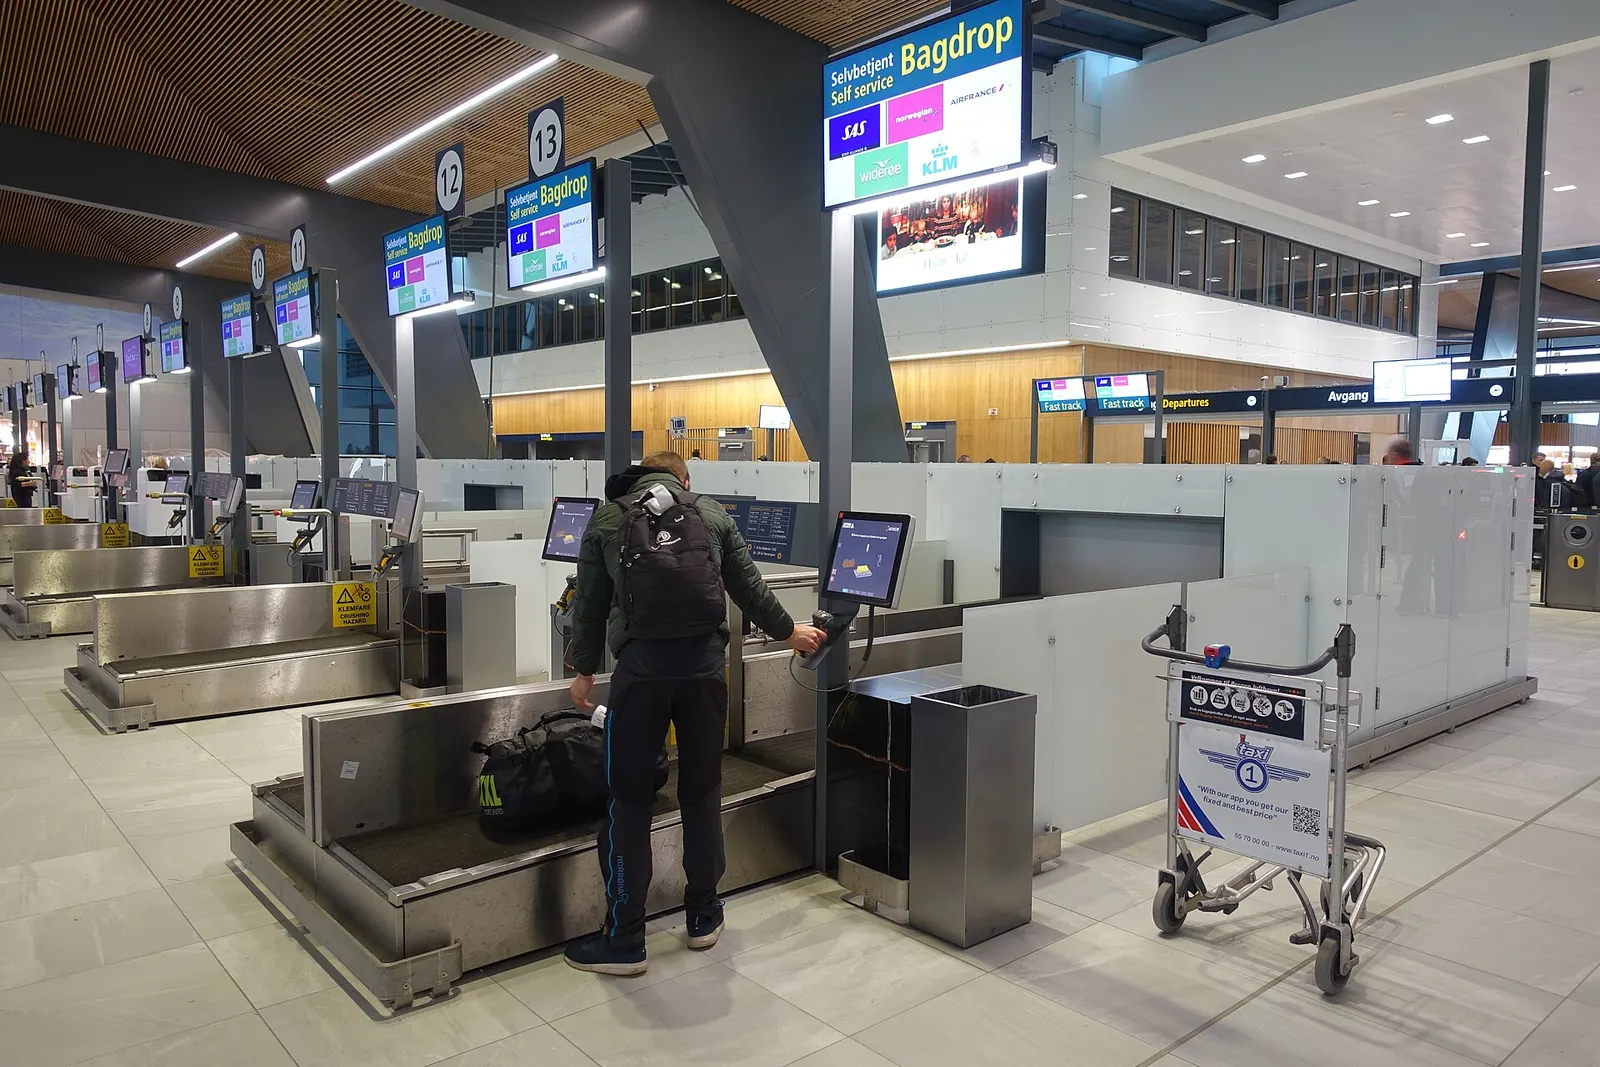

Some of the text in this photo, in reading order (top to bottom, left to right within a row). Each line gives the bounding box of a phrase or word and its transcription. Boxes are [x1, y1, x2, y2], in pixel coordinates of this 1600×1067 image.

[901, 15, 1013, 76] Bagdrop
[832, 52, 894, 87] Selvbetjent
[832, 75, 894, 106] Self service
[895, 107, 933, 124] norwegian
[842, 120, 867, 141] SAS
[534, 124, 557, 162] 13
[922, 156, 958, 176] KLM
[441, 164, 458, 197] 12
[510, 190, 538, 208] Selvbetjent
[541, 175, 588, 207] Bagdrop
[510, 204, 538, 220] Self service
[408, 224, 442, 250] Bagdrop
[516, 232, 528, 244] SAS
[294, 240, 302, 262] 11
[254, 258, 262, 279] 10
[552, 260, 568, 273] KLM
[288, 276, 308, 294] Bagdrop
[1103, 399, 1120, 408] Fast
[1122, 398, 1144, 408] track
[1162, 398, 1210, 409] Departures
[1328, 390, 1369, 402] Avgang
[1044, 401, 1082, 411] Fast track
[338, 604, 371, 612] KLEMFARE
[1238, 743, 1272, 760] taxi
[1246, 766, 1257, 783] 1
[1203, 796, 1220, 806] fixed
[1222, 800, 1235, 810] and
[1237, 805, 1253, 815] best
[1230, 794, 1244, 803] app
[1246, 798, 1259, 807] you
[1260, 802, 1274, 810] get
[1275, 806, 1288, 814] our
[1275, 845, 1319, 861] www.taxi1.no
